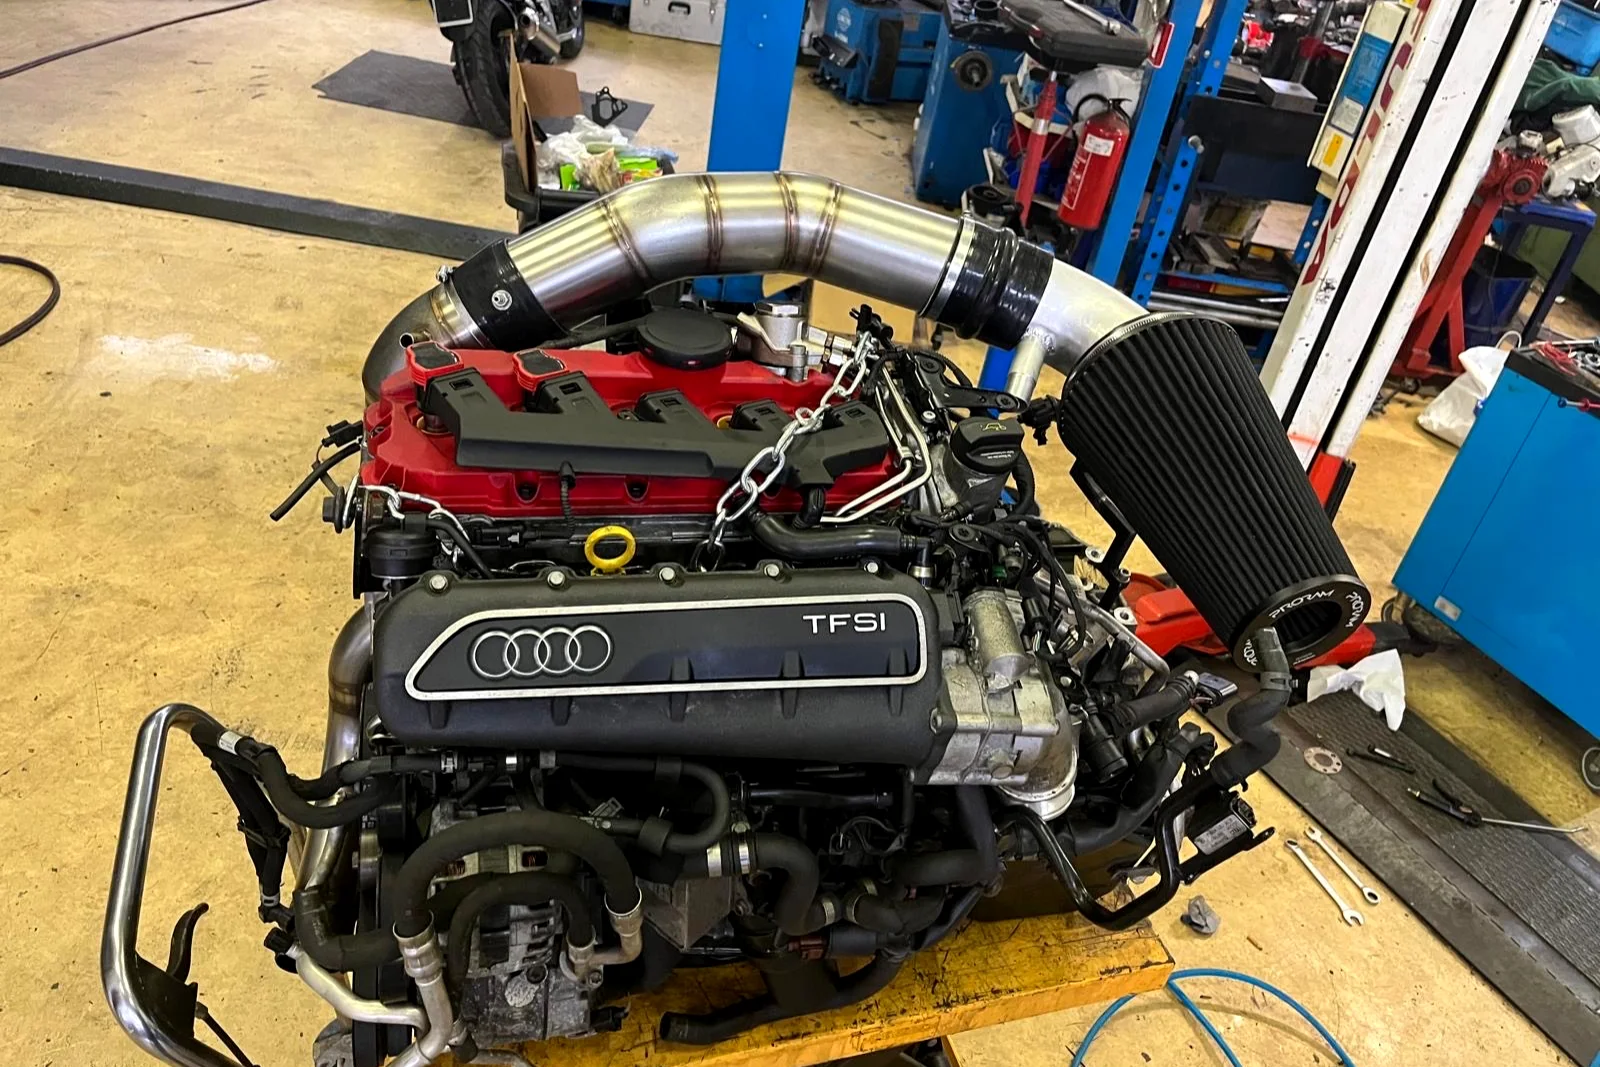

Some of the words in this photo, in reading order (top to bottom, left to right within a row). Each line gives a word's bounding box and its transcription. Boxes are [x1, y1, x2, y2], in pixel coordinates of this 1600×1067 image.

[1302, 0, 1431, 285] FULDA
[1268, 589, 1335, 619] PRORAM
[803, 612, 886, 634] TFSI
